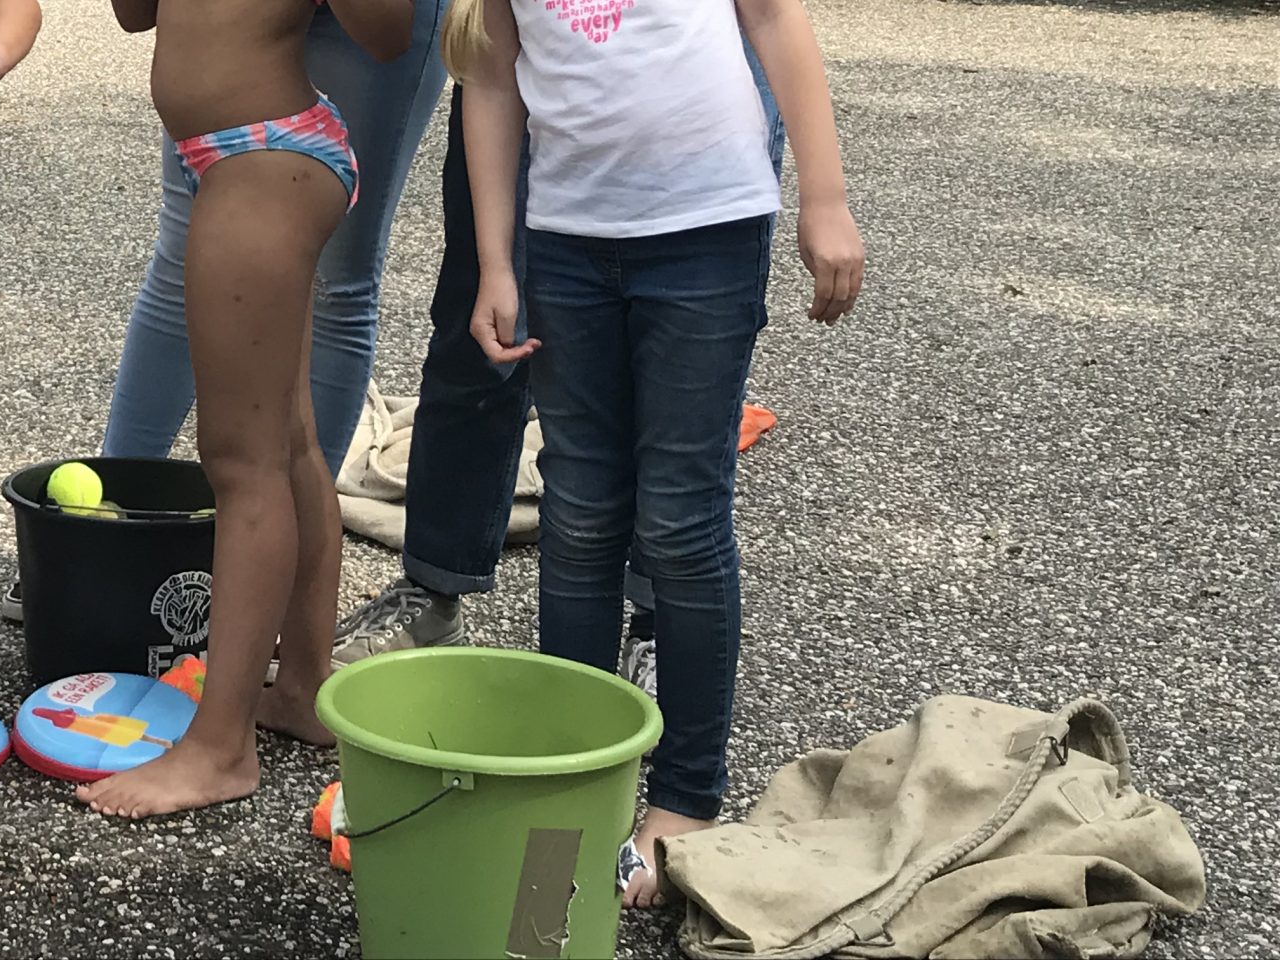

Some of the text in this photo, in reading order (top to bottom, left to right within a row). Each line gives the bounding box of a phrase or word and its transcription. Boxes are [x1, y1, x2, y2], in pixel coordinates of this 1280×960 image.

[570, 11, 622, 33] every
[587, 30, 609, 43] day
[181, 572, 196, 583] DIE
[196, 574, 211, 589] KLU
